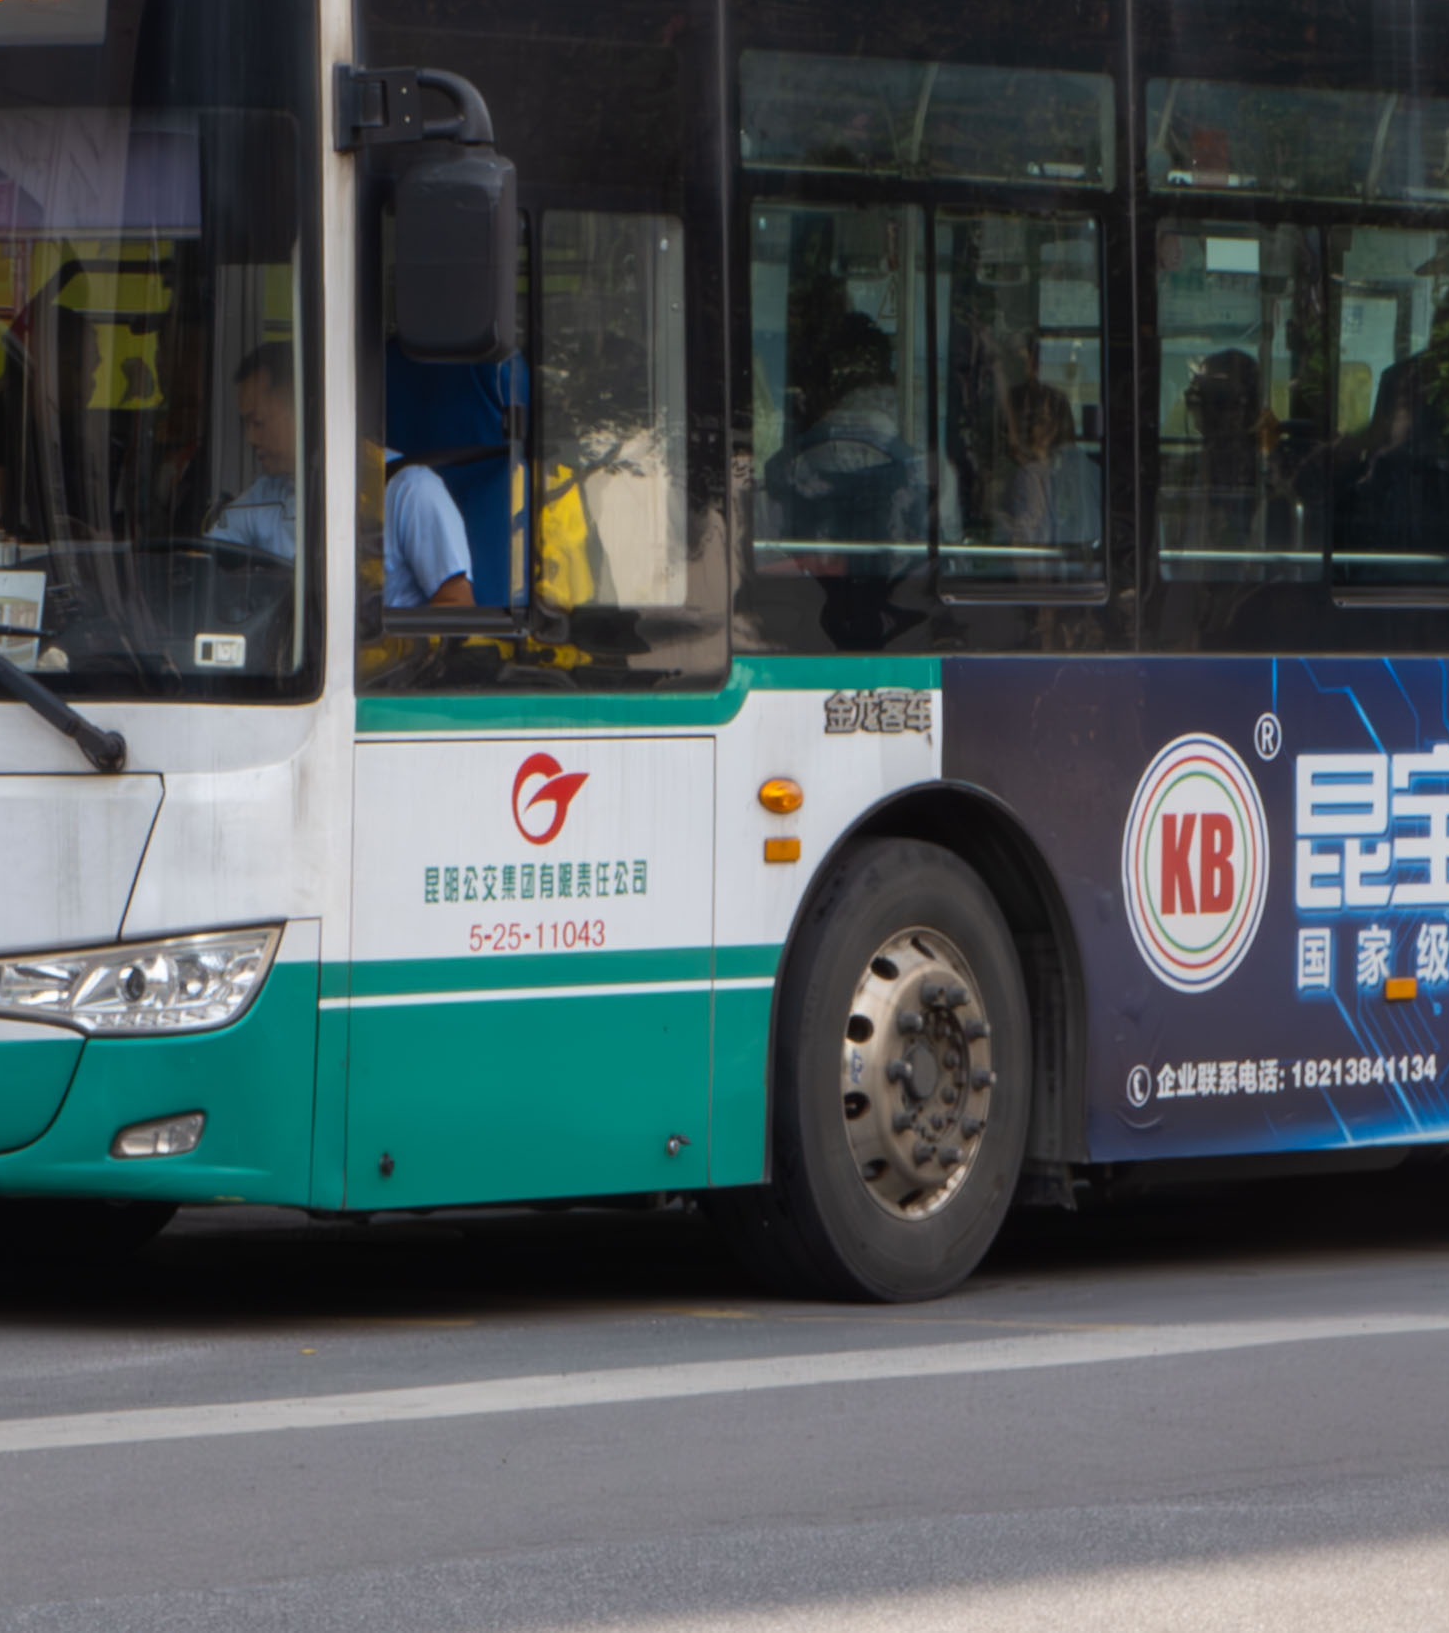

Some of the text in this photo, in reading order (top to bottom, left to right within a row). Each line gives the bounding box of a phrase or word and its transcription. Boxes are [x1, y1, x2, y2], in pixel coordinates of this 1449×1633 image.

[424, 859, 648, 904] 昆明公交集团有限责任公司
[1161, 813, 1235, 916] KB
[468, 919, 606, 952] 5-25-11043
